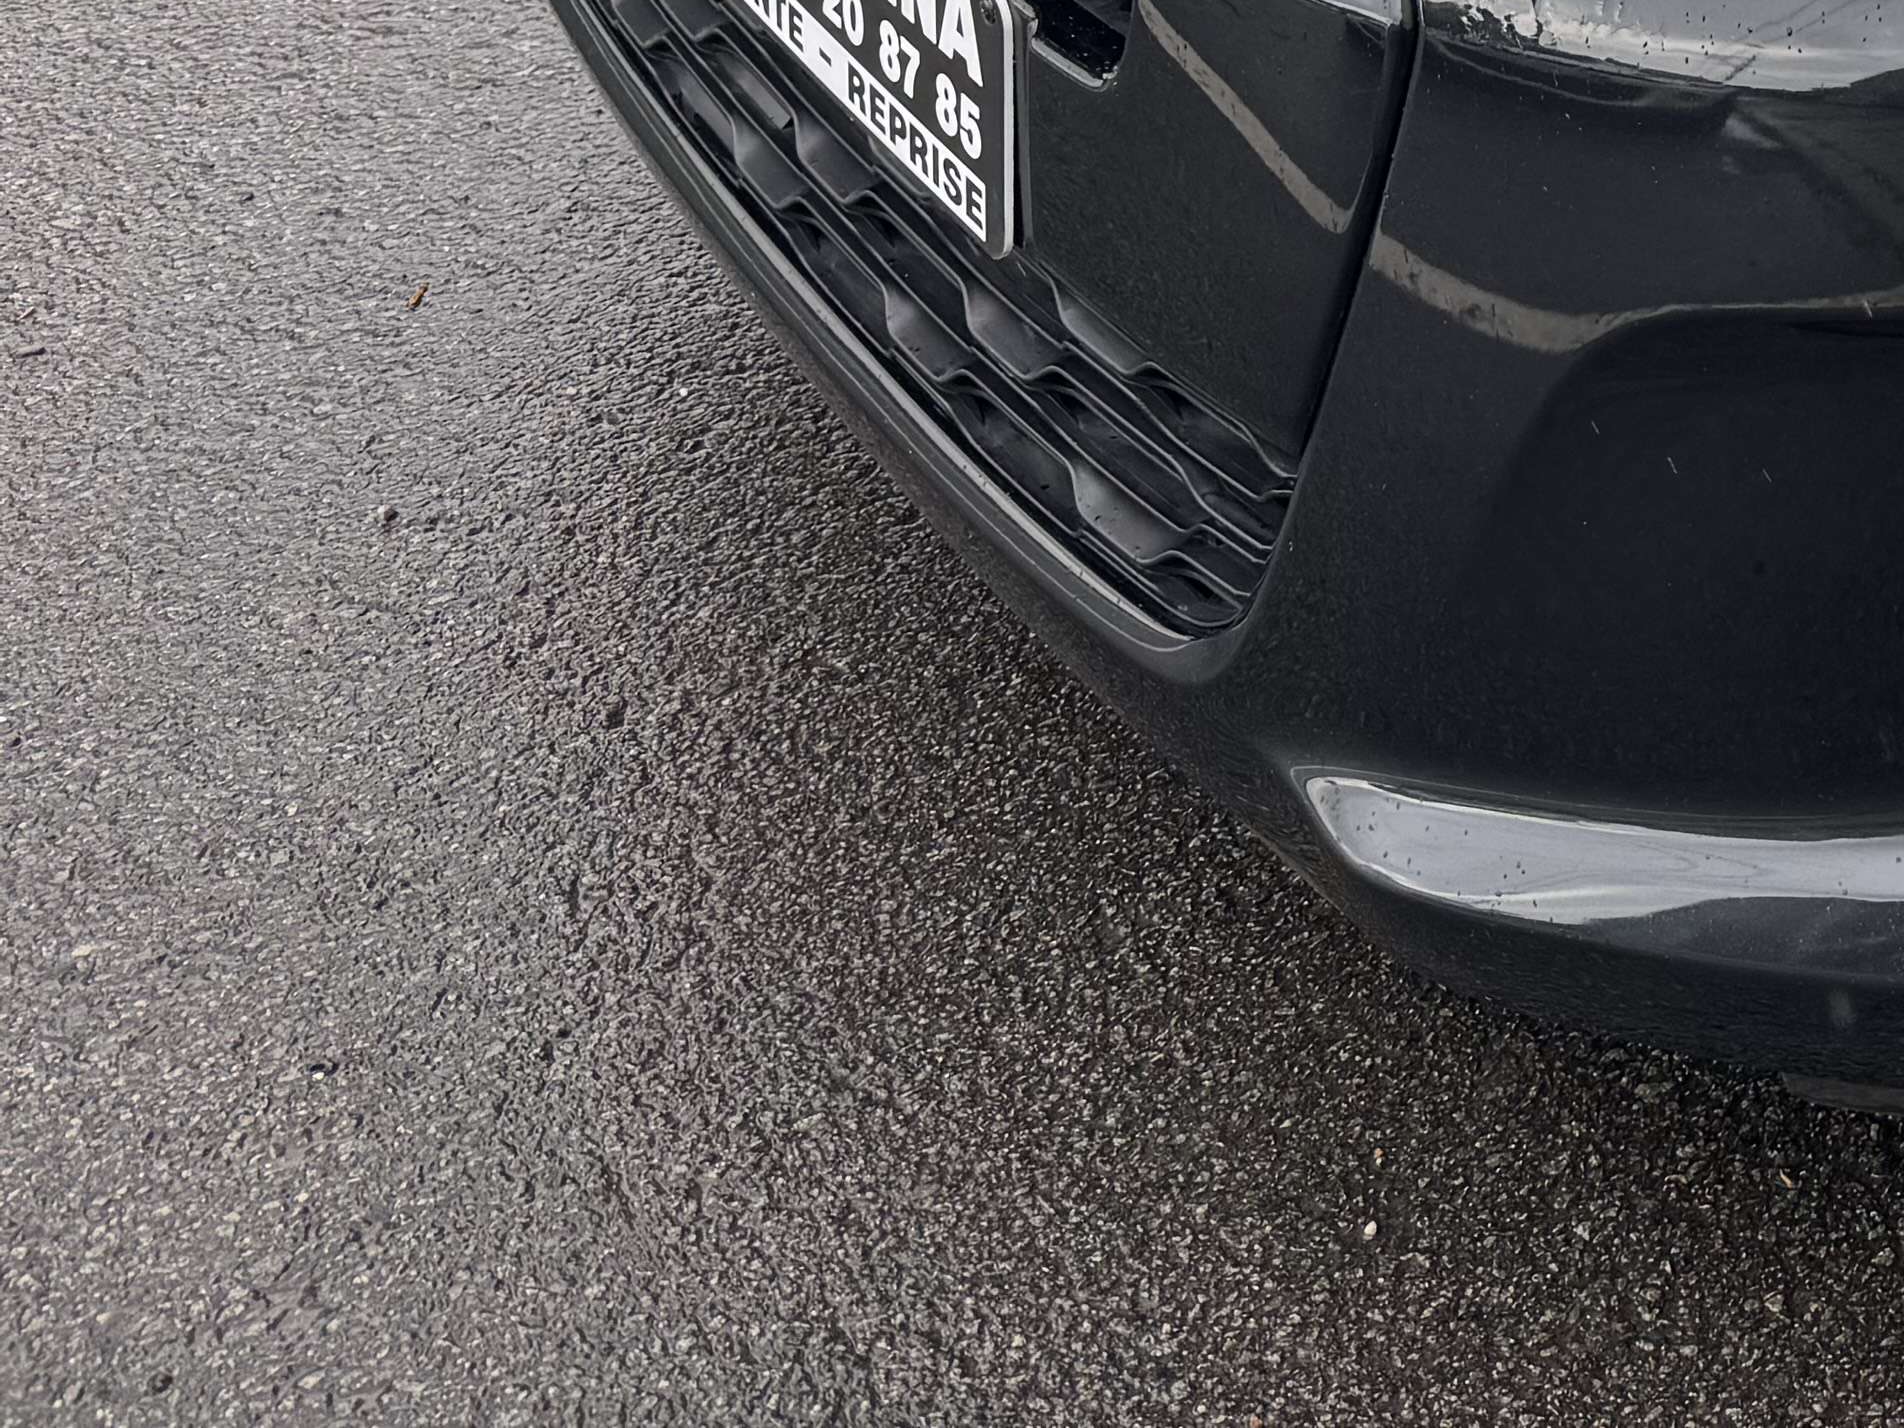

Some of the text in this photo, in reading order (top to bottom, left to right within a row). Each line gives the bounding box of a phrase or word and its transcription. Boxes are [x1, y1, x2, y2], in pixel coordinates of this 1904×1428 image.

[847, 61, 984, 232] REPRISE
[878, 18, 922, 100] 87
[935, 71, 983, 161] 85
